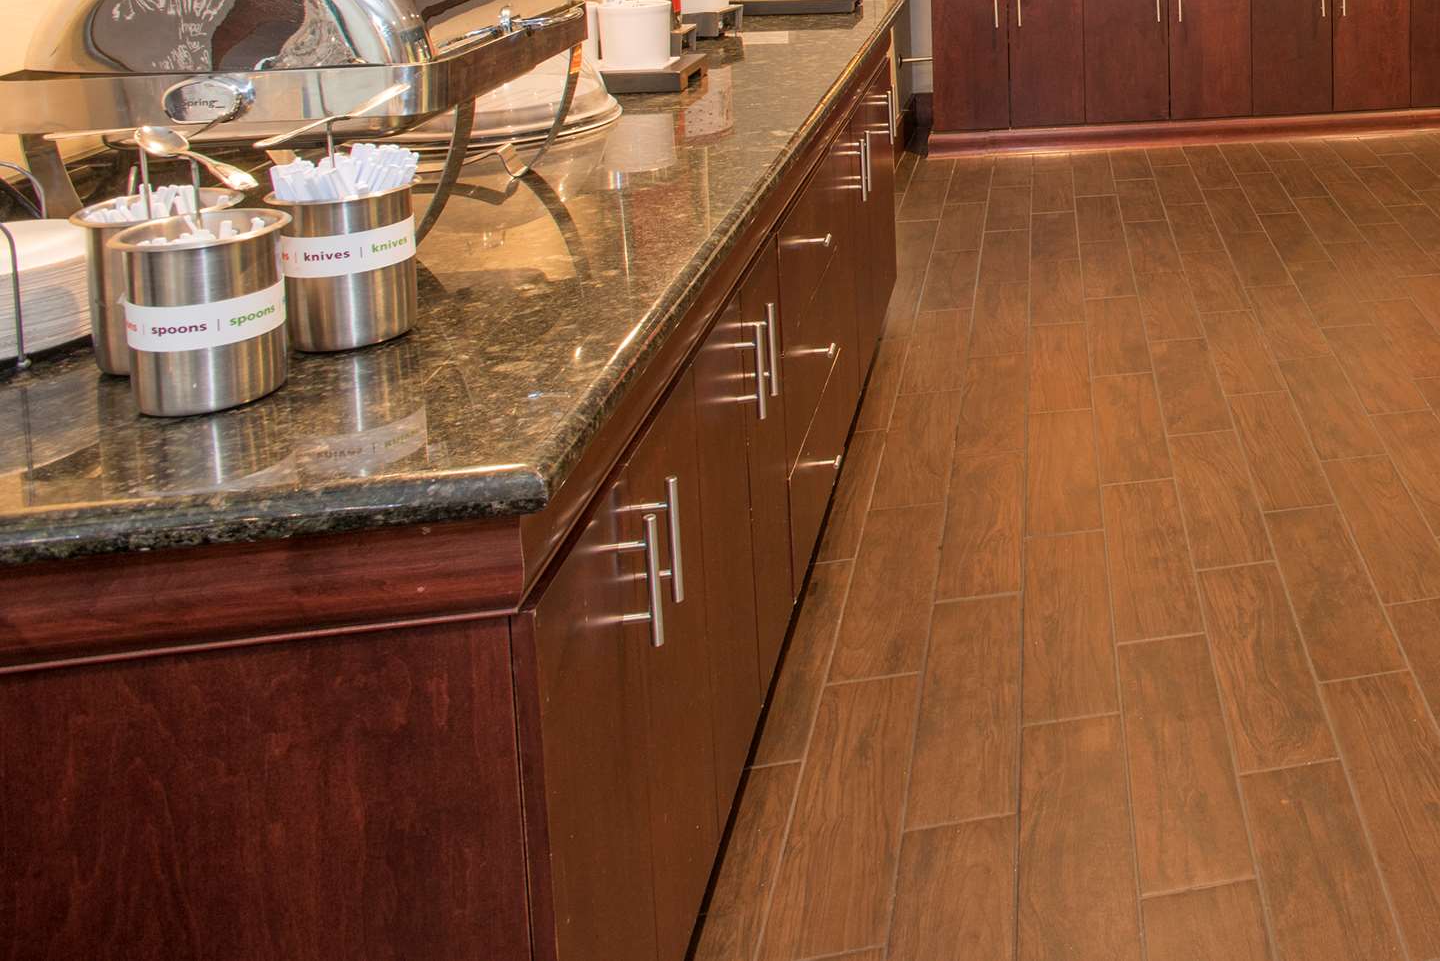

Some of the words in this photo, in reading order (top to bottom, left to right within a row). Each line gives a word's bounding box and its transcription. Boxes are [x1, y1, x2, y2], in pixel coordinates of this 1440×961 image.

[304, 250, 350, 262] knives
[371, 237, 408, 254] knives
[151, 322, 207, 337] spoons
[229, 304, 275, 327] spoons
